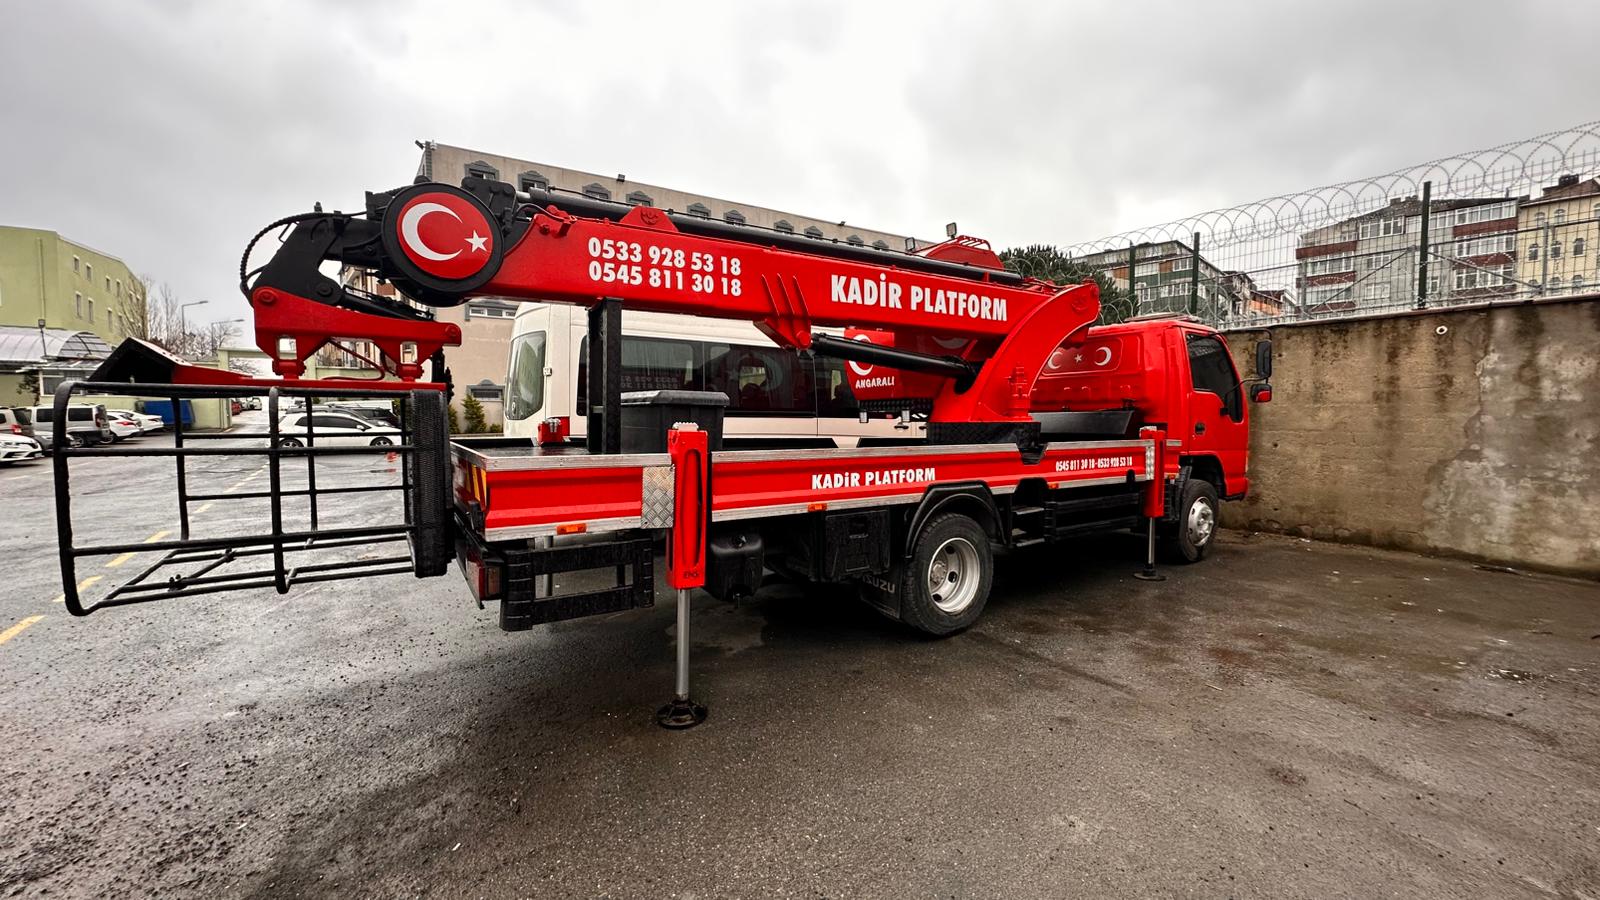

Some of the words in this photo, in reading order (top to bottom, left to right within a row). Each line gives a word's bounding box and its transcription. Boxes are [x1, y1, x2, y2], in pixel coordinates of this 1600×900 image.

[588, 237, 642, 262] 0533
[648, 246, 686, 269] 928
[691, 252, 714, 273] 53
[720, 257, 742, 276] 18
[588, 261, 643, 285] 0545
[648, 268, 683, 290] 811
[691, 274, 714, 294] 30
[720, 278, 742, 297] 18
[831, 272, 902, 309] KADİR
[910, 285, 1007, 322] PLATFORM
[855, 376, 895, 389] ANGARALI
[865, 468, 936, 487] PLATFORM
[1056, 460, 1069, 472] 0545
[1070, 460, 1080, 471] 811
[1081, 459, 1088, 470] 30
[1120, 456, 1126, 467] 53
